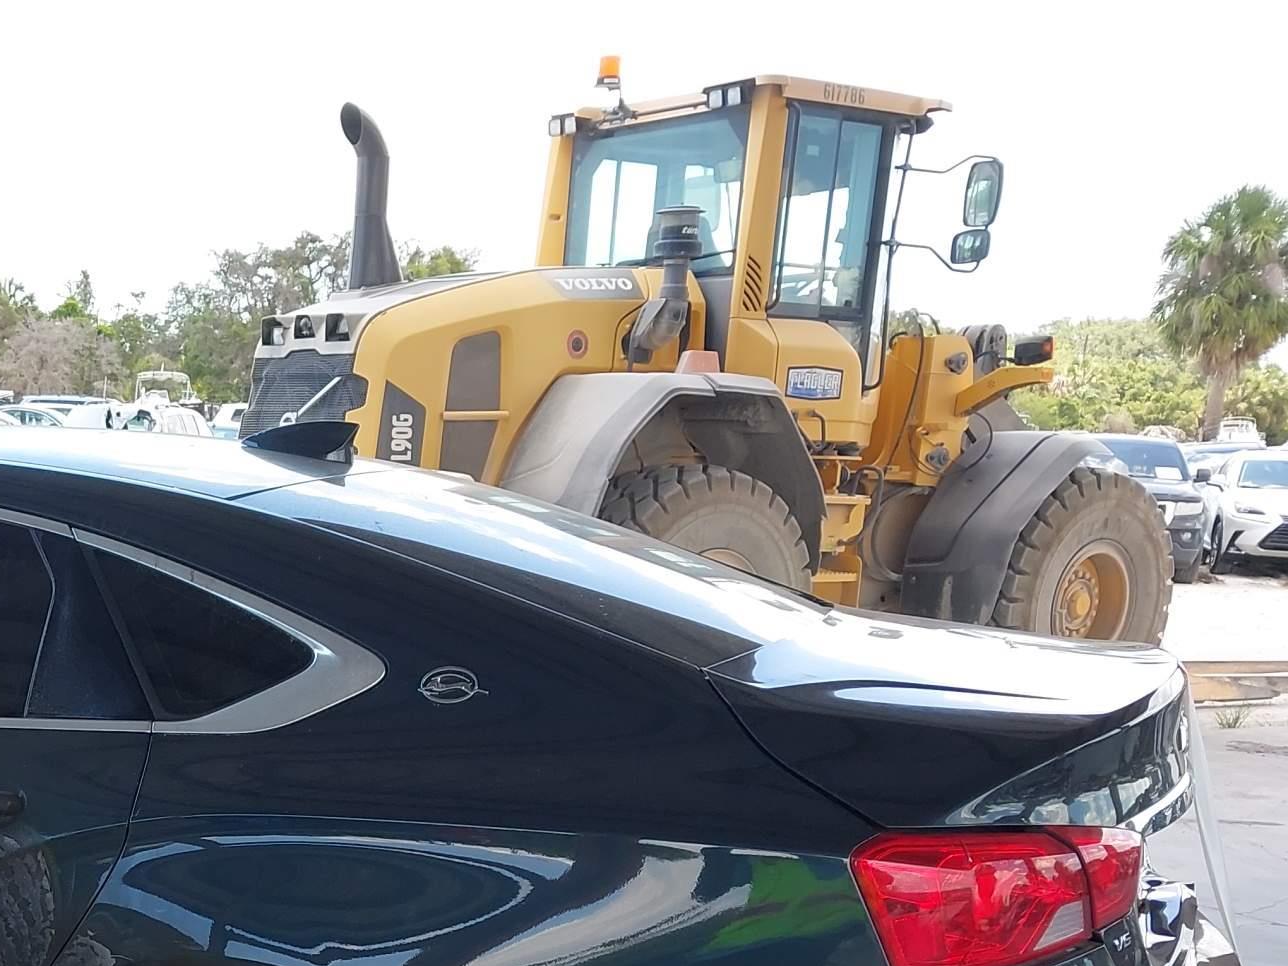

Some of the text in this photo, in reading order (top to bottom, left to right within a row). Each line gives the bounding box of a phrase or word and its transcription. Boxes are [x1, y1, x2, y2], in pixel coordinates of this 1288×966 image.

[824, 82, 865, 105] 617786
[555, 278, 633, 290] VOLVO
[390, 413, 413, 461] L90G
